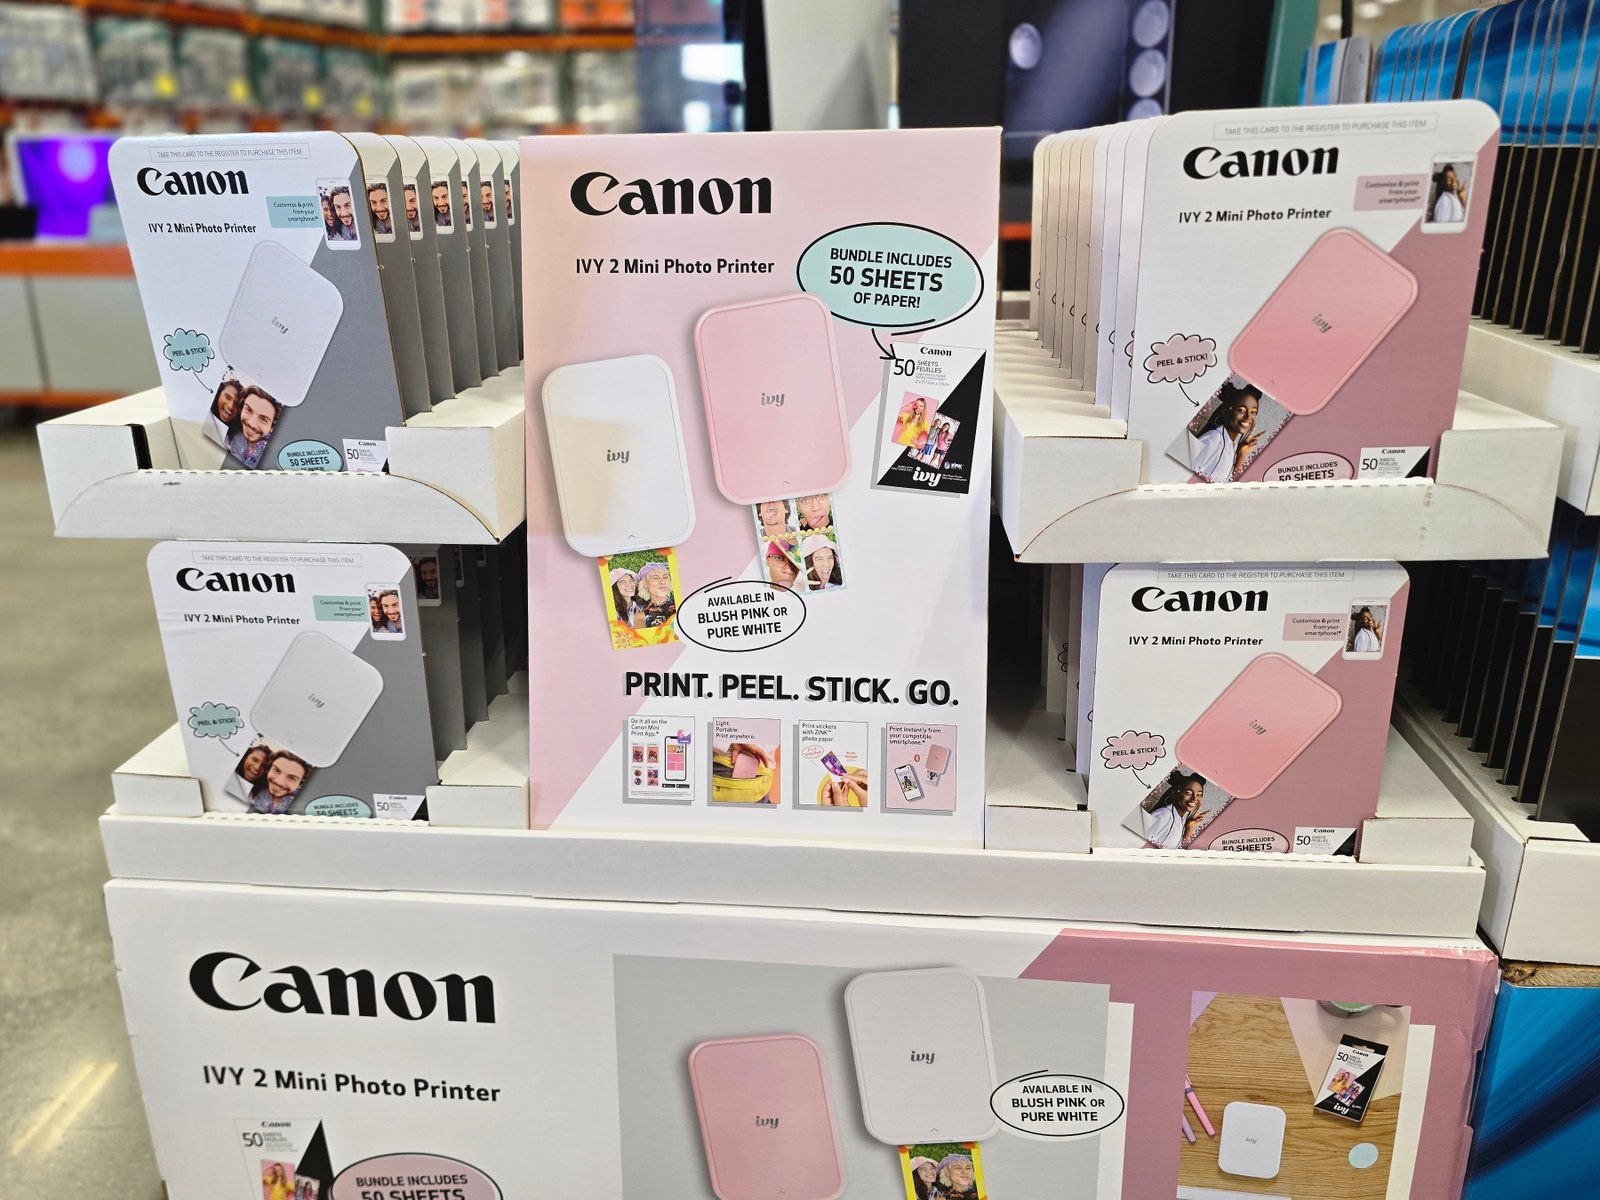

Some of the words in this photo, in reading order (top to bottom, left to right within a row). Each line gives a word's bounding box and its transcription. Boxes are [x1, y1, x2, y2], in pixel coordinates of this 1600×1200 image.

[1183, 146, 1340, 180] Canon
[137, 167, 249, 196] Canon
[570, 171, 772, 216] Canon
[1179, 212, 1200, 223] IVY
[1204, 211, 1212, 222] 2
[1216, 210, 1243, 222] Mini
[1246, 209, 1284, 221] Photo
[1287, 208, 1332, 220] Printer
[149, 223, 164, 232] IVY
[166, 223, 172, 232] 2
[174, 223, 194, 233] Mini
[197, 223, 222, 233] Photo
[224, 223, 256, 233] Printer
[830, 248, 883, 264] BUNDLE
[886, 250, 952, 269] INCLUDES
[576, 259, 604, 274] IVY
[609, 259, 620, 274] 2
[624, 258, 659, 274] Mini
[664, 259, 712, 274] Photo
[716, 258, 775, 274] Printer
[829, 266, 855, 286] 50
[860, 268, 944, 292] SHEETS
[853, 292, 871, 306] OF
[874, 293, 921, 308] PAPER!
[272, 316, 288, 334] ivy
[1312, 314, 1332, 333] ivy
[172, 349, 186, 357] PEEL
[920, 346, 952, 356] Canon
[894, 359, 915, 376] 50
[1156, 359, 1174, 368] PEEL
[1184, 354, 1208, 363] STICK!
[760, 392, 785, 408] ivy
[289, 458, 300, 466] 50
[300, 456, 330, 466] SHEETS
[346, 448, 360, 460] 50
[606, 449, 630, 464] ivy
[1278, 466, 1304, 474] BUNDLE
[1306, 461, 1338, 471] INCLUDES
[1362, 458, 1378, 470] 50
[912, 466, 941, 487] ivy
[1279, 474, 1292, 482] 50
[1294, 470, 1334, 482] SHEETS
[176, 567, 296, 593] Canon
[707, 593, 762, 607] AVAILABLE
[764, 592, 775, 602] IN
[1131, 586, 1269, 612] Canon
[184, 614, 200, 622] IVY
[203, 614, 210, 622] 2
[212, 614, 234, 624] Mini
[236, 614, 264, 624] Photo
[266, 616, 300, 625] Printer
[697, 609, 738, 624] BLUSH
[741, 606, 770, 621] PINK
[773, 606, 788, 618] OR
[1326, 618, 1340, 626] print
[707, 624, 740, 640] PURE
[742, 622, 782, 637] WHITE
[1129, 636, 1148, 646] IVY
[1152, 636, 1158, 646] 2
[1162, 636, 1186, 646] Mini
[1188, 636, 1221, 646] Photo
[1224, 636, 1264, 646] Printer
[625, 672, 713, 699] PRINT.
[721, 674, 799, 700] PEEL.
[808, 676, 900, 704] STICK.
[908, 680, 960, 706] GO.
[904, 726, 926, 734] instantly
[1249, 720, 1267, 735] ivy
[1136, 746, 1158, 754] STICK!
[328, 808, 358, 816] SHEETS
[377, 802, 390, 811] 50
[1222, 838, 1246, 846] BUNDLE
[1246, 836, 1276, 844] INCLUDES
[1236, 843, 1272, 852] SHEETS
[1296, 836, 1311, 846] 50
[189, 951, 496, 1024] Canon
[910, 1050, 936, 1065] ivy
[1336, 1052, 1349, 1062] 50
[202, 1065, 244, 1084] IVY
[252, 1068, 268, 1088] 2
[274, 1070, 327, 1092] Mini
[335, 1074, 406, 1097] Photo
[414, 1078, 501, 1102] Printer
[1022, 1084, 1078, 1094] AVAILABLE
[1080, 1084, 1092, 1093] IN
[1012, 1096, 1054, 1108] BLUSH
[1056, 1096, 1086, 1108] PINK
[1090, 1098, 1106, 1108] OR
[1334, 1102, 1350, 1114] ivy
[755, 1114, 780, 1130] ivy
[1020, 1110, 1055, 1122] PURE
[1058, 1110, 1098, 1122] WHITE
[262, 1120, 292, 1128] Canon
[242, 1132, 264, 1147] 50
[356, 1176, 405, 1187] BUNDLE
[408, 1174, 468, 1186] INCLUDES
[362, 1190, 384, 1200] 50
[390, 1189, 466, 1200] SHEETS
